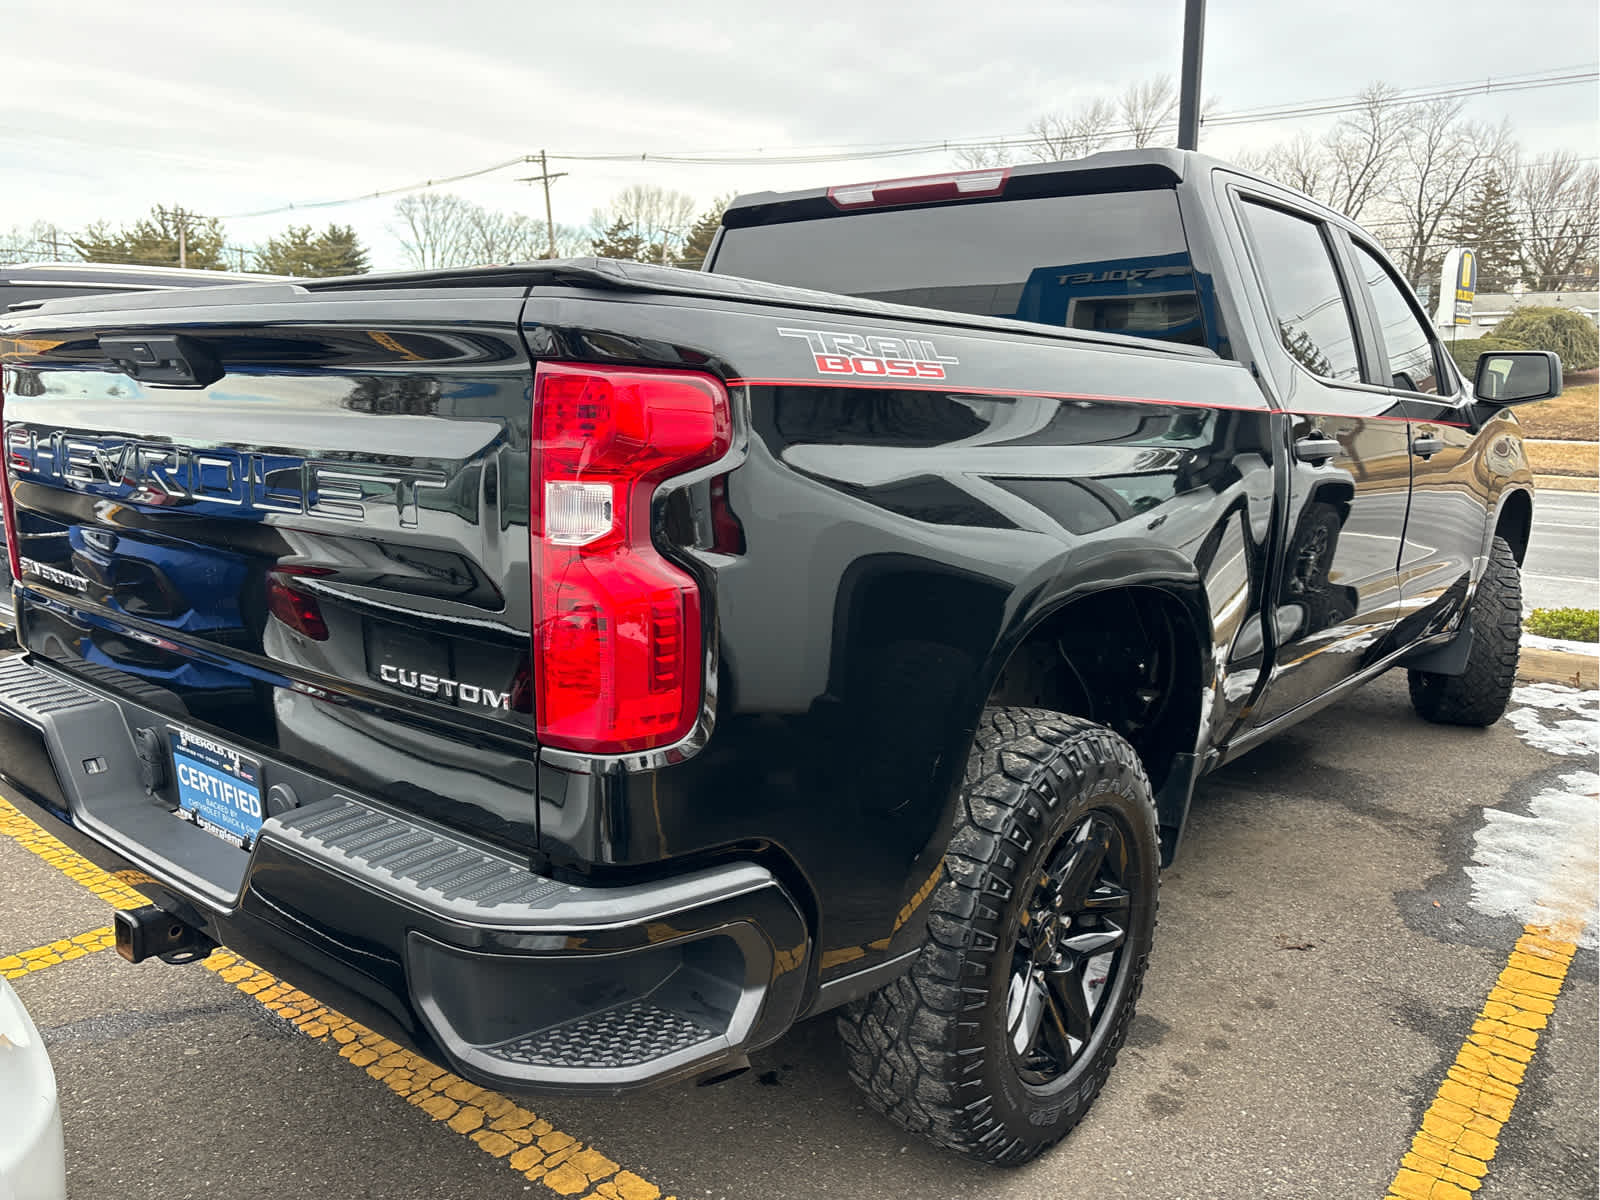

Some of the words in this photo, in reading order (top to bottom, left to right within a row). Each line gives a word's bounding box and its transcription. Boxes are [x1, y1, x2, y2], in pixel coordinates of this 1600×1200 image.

[776, 327, 959, 365] TRAIL
[814, 354, 946, 379] BOSS
[5, 426, 449, 529] CHEVROLET
[380, 664, 510, 711] CUSTOM
[178, 763, 261, 818] CERTIFIED
